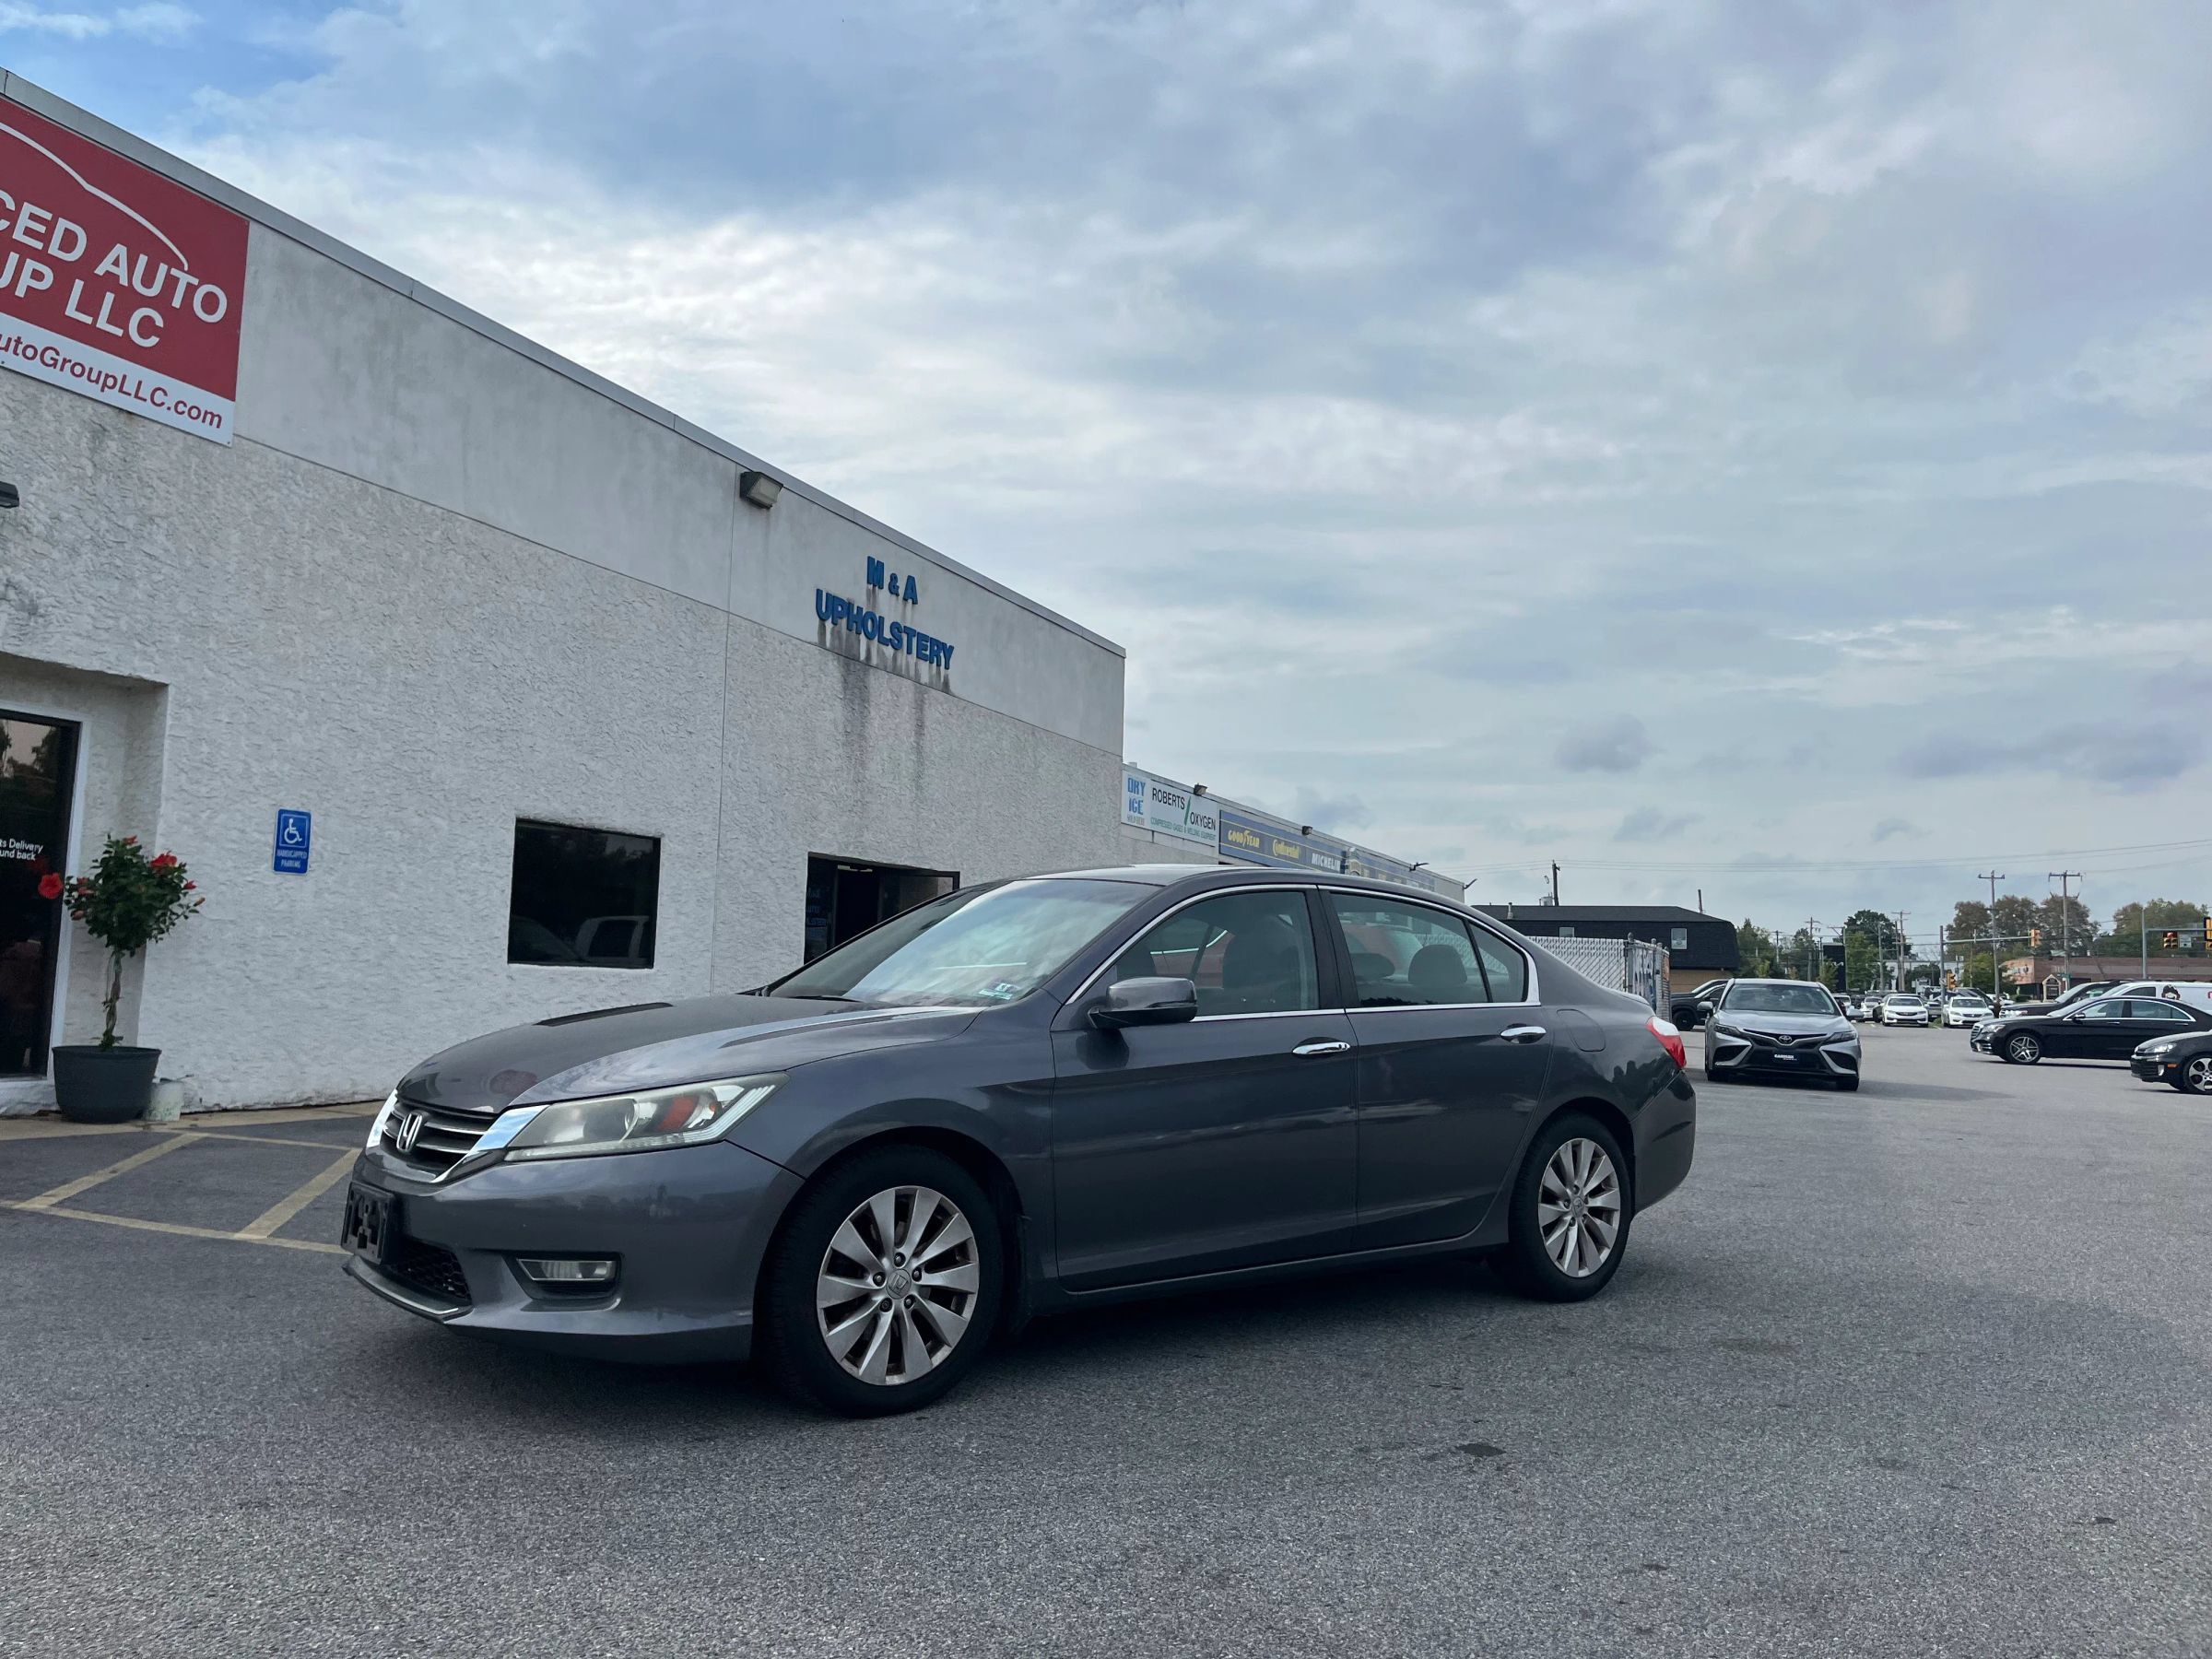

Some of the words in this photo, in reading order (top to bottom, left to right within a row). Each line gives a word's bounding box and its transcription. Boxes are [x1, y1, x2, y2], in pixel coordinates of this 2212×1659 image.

[94, 243, 228, 324] AUTO
[65, 279, 164, 347] LLC
[866, 556, 885, 590] M
[888, 572, 900, 596] &
[902, 575, 919, 605] A
[816, 588, 955, 670] UPHOLSTERY
[1127, 777, 1146, 796] DRY
[1128, 796, 1144, 816] ICE
[1152, 788, 1185, 810] ROBERTS
[1189, 812, 1216, 830] OXYGEN
[9, 838, 43, 854] Delivery
[17, 850, 36, 861] back
[1312, 853, 1341, 873] MICHELIN
